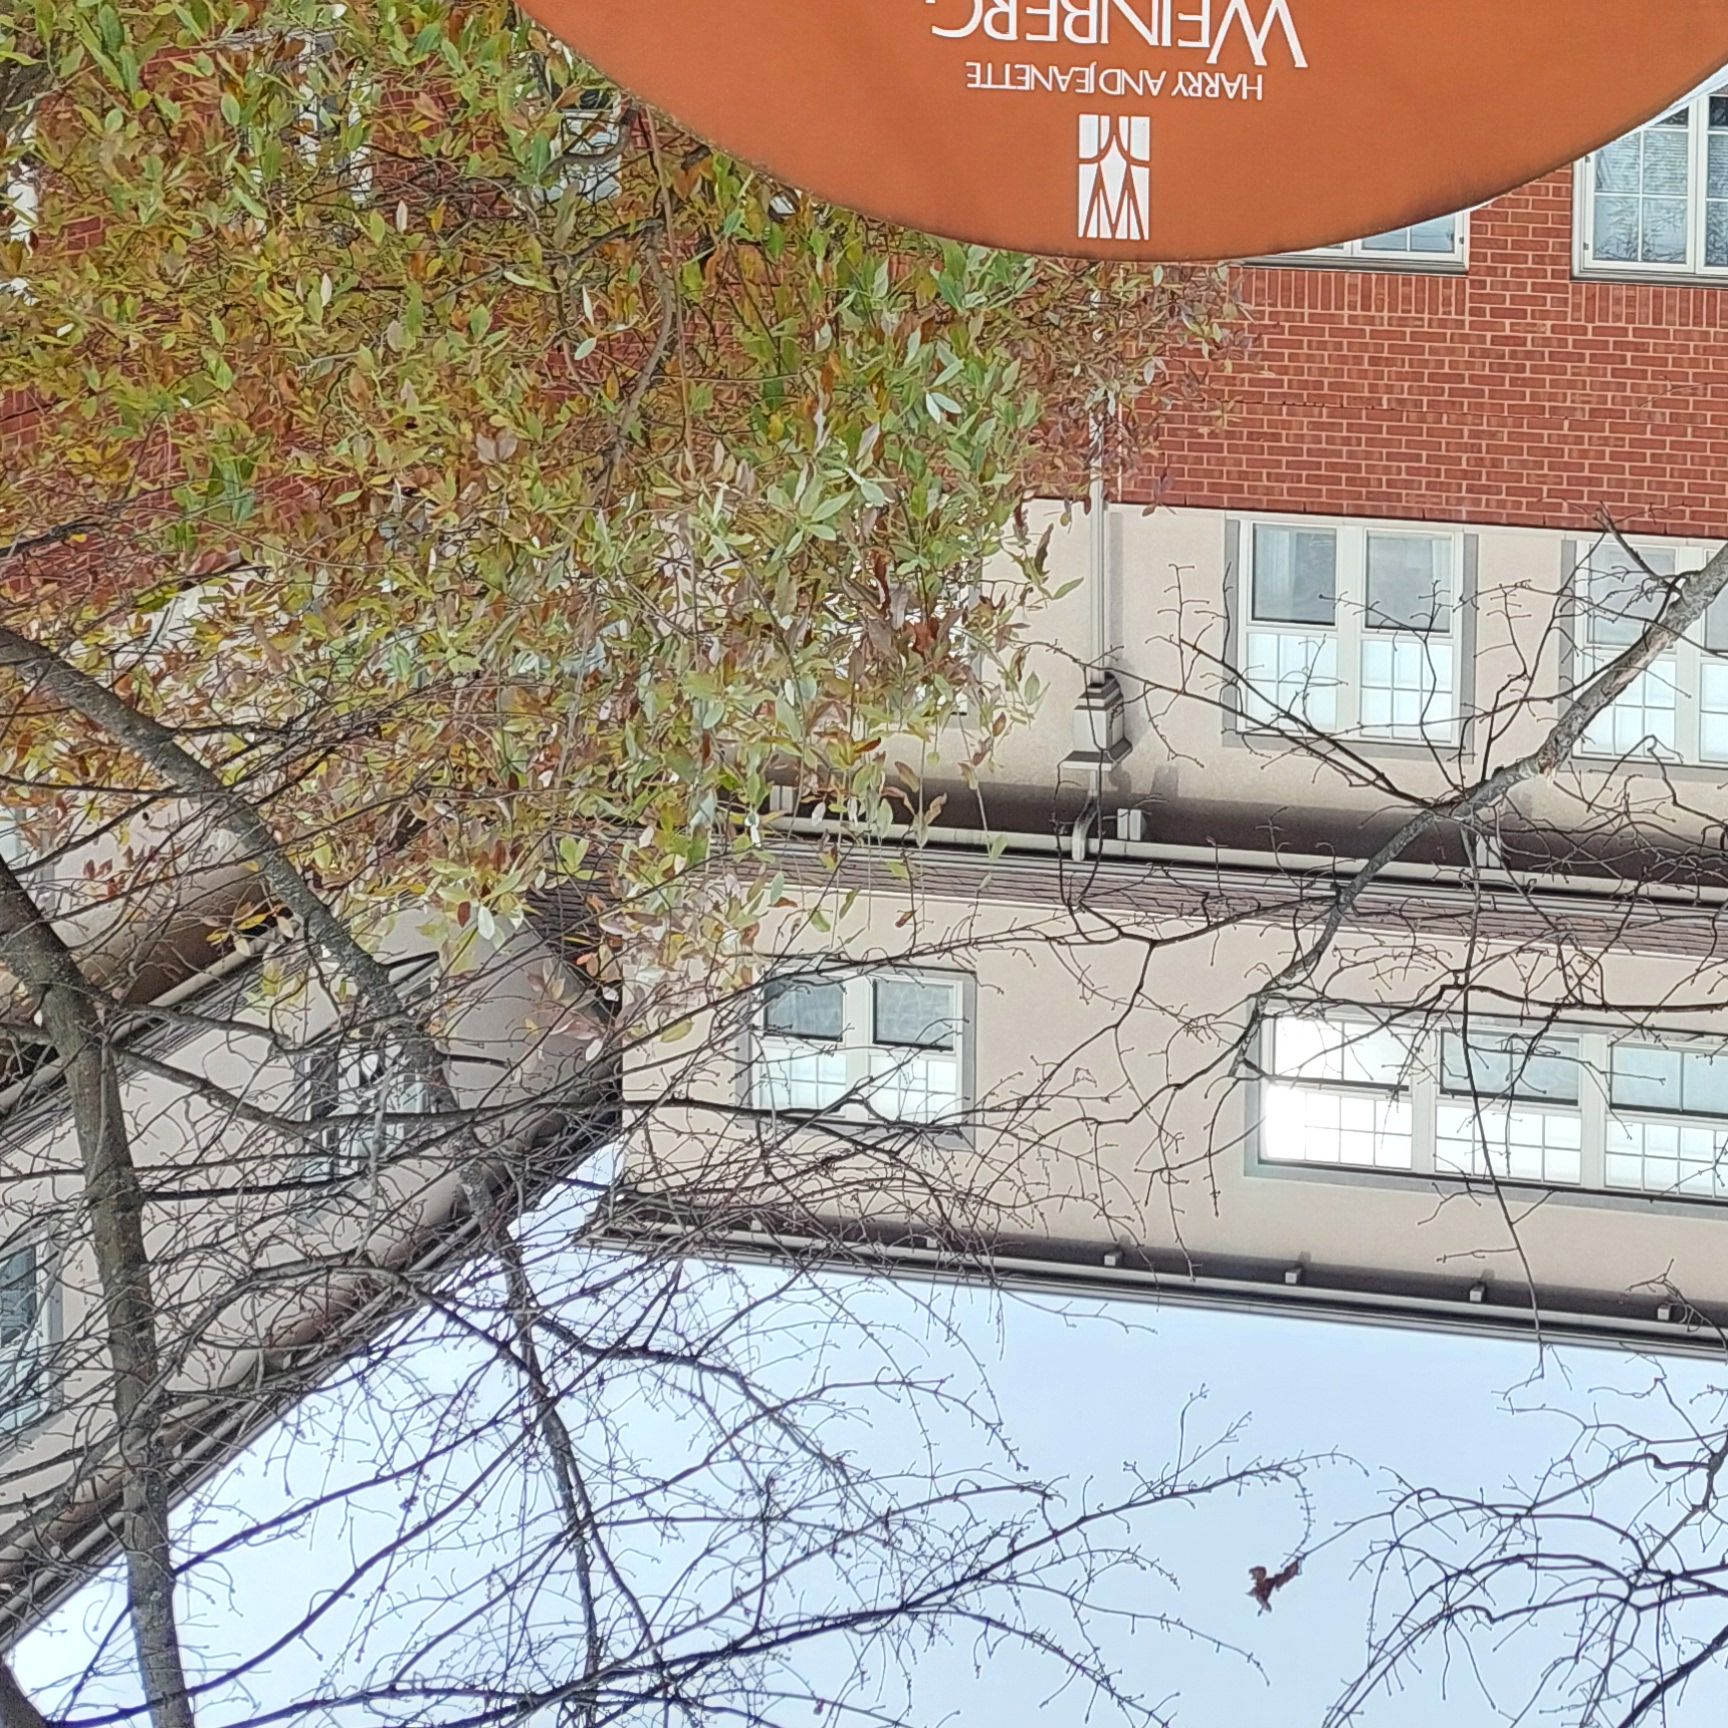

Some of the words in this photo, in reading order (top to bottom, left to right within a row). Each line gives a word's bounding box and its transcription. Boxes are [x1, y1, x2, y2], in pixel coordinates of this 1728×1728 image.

[965, 61, 1097, 94] JEANETTE
[1099, 68, 1167, 97] AND
[1171, 71, 1263, 102] HARRY
